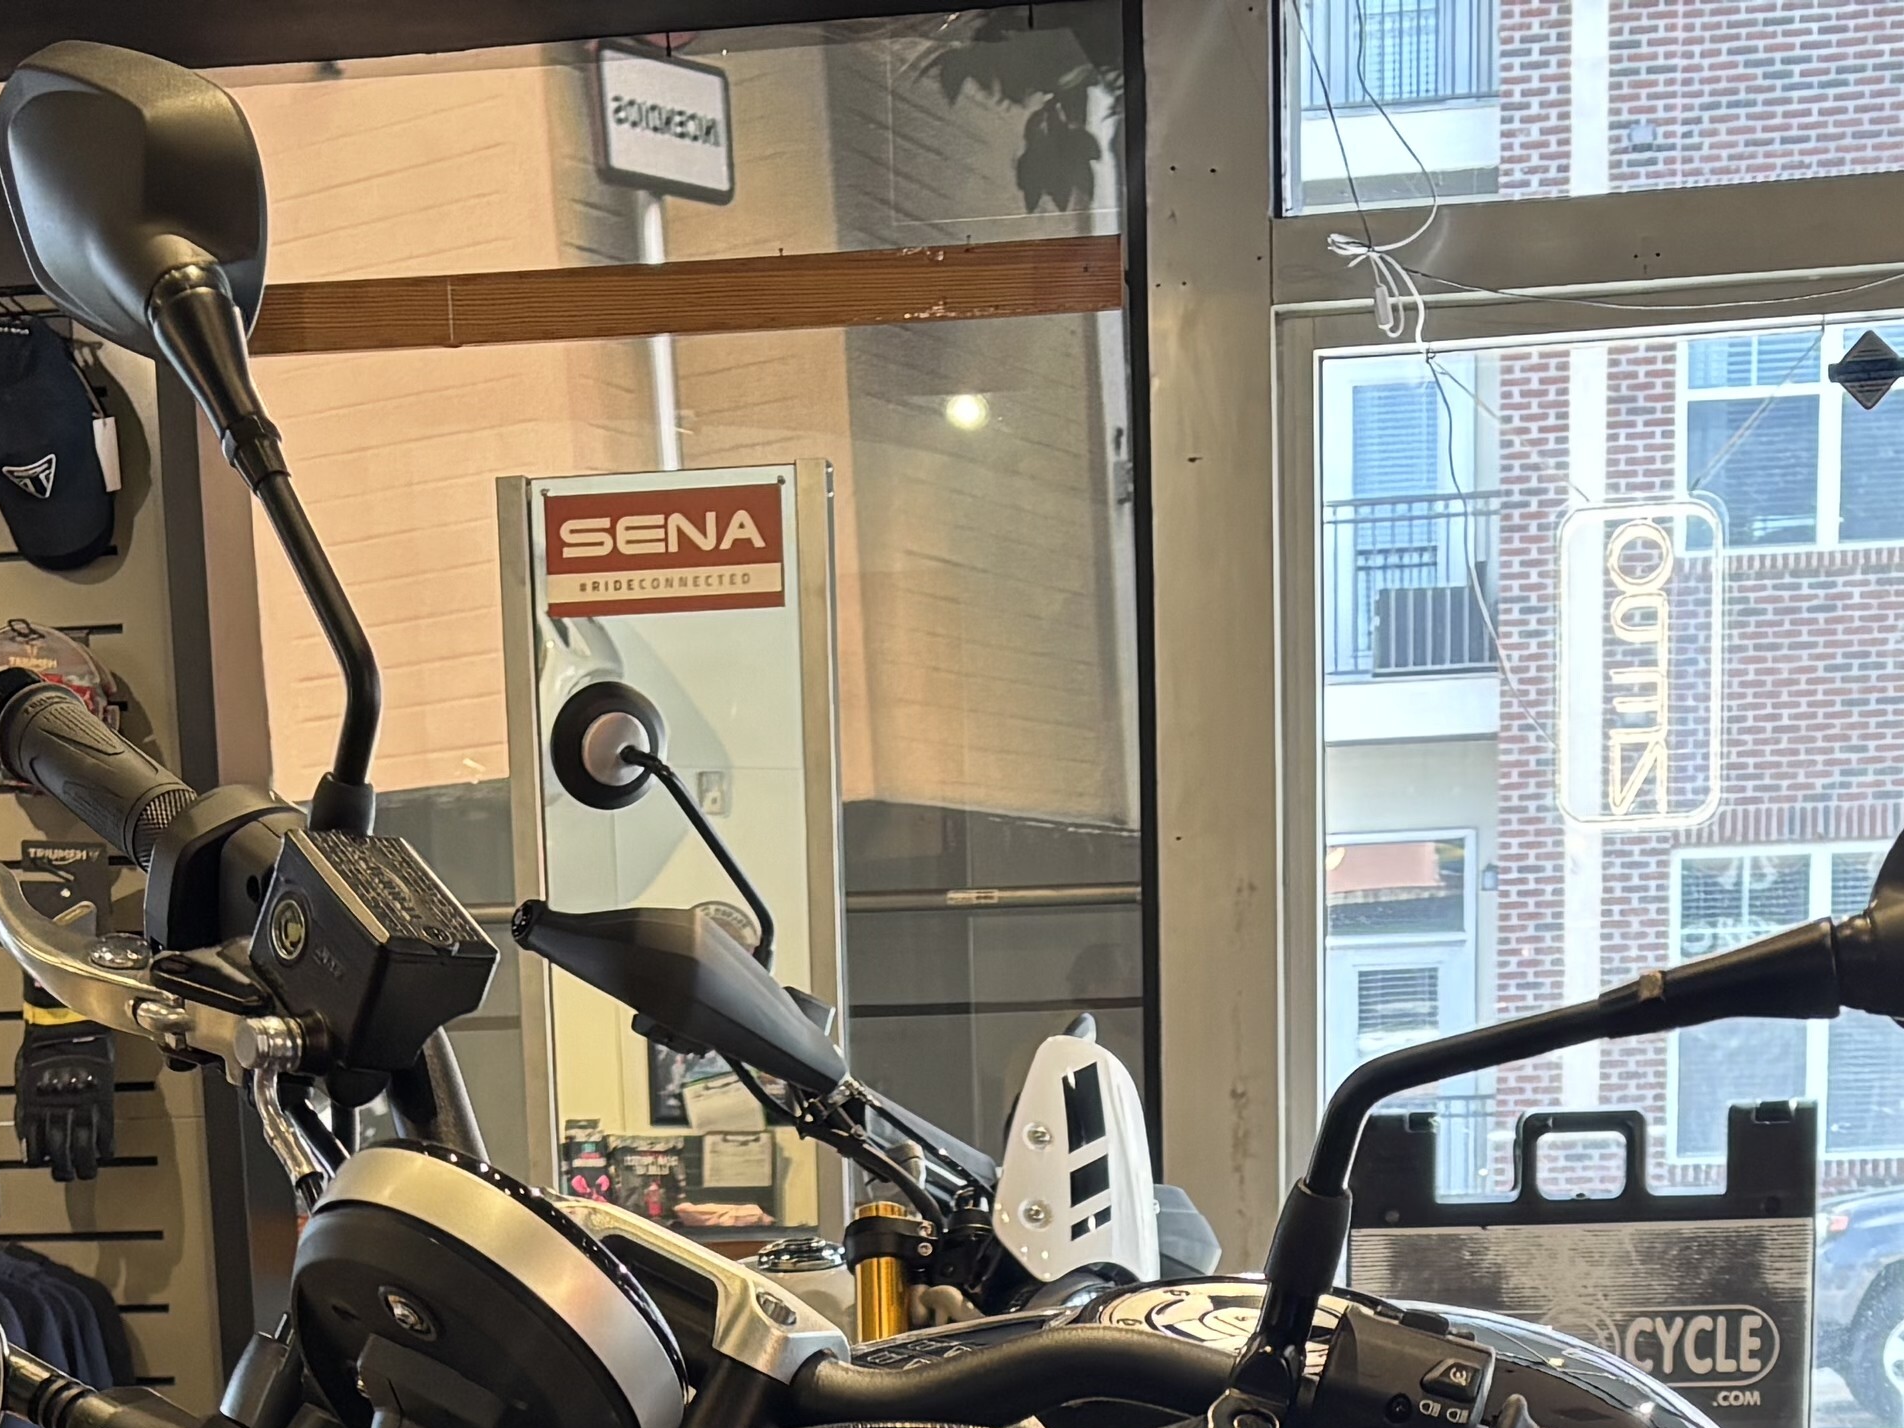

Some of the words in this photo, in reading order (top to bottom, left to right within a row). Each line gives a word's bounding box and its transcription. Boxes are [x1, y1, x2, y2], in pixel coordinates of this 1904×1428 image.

[559, 509, 767, 559] SENA
[579, 572, 752, 594] #RIDECONNECTED
[1624, 1315, 1764, 1375] CYCLE
[1711, 1390, 1763, 1407] .COM
